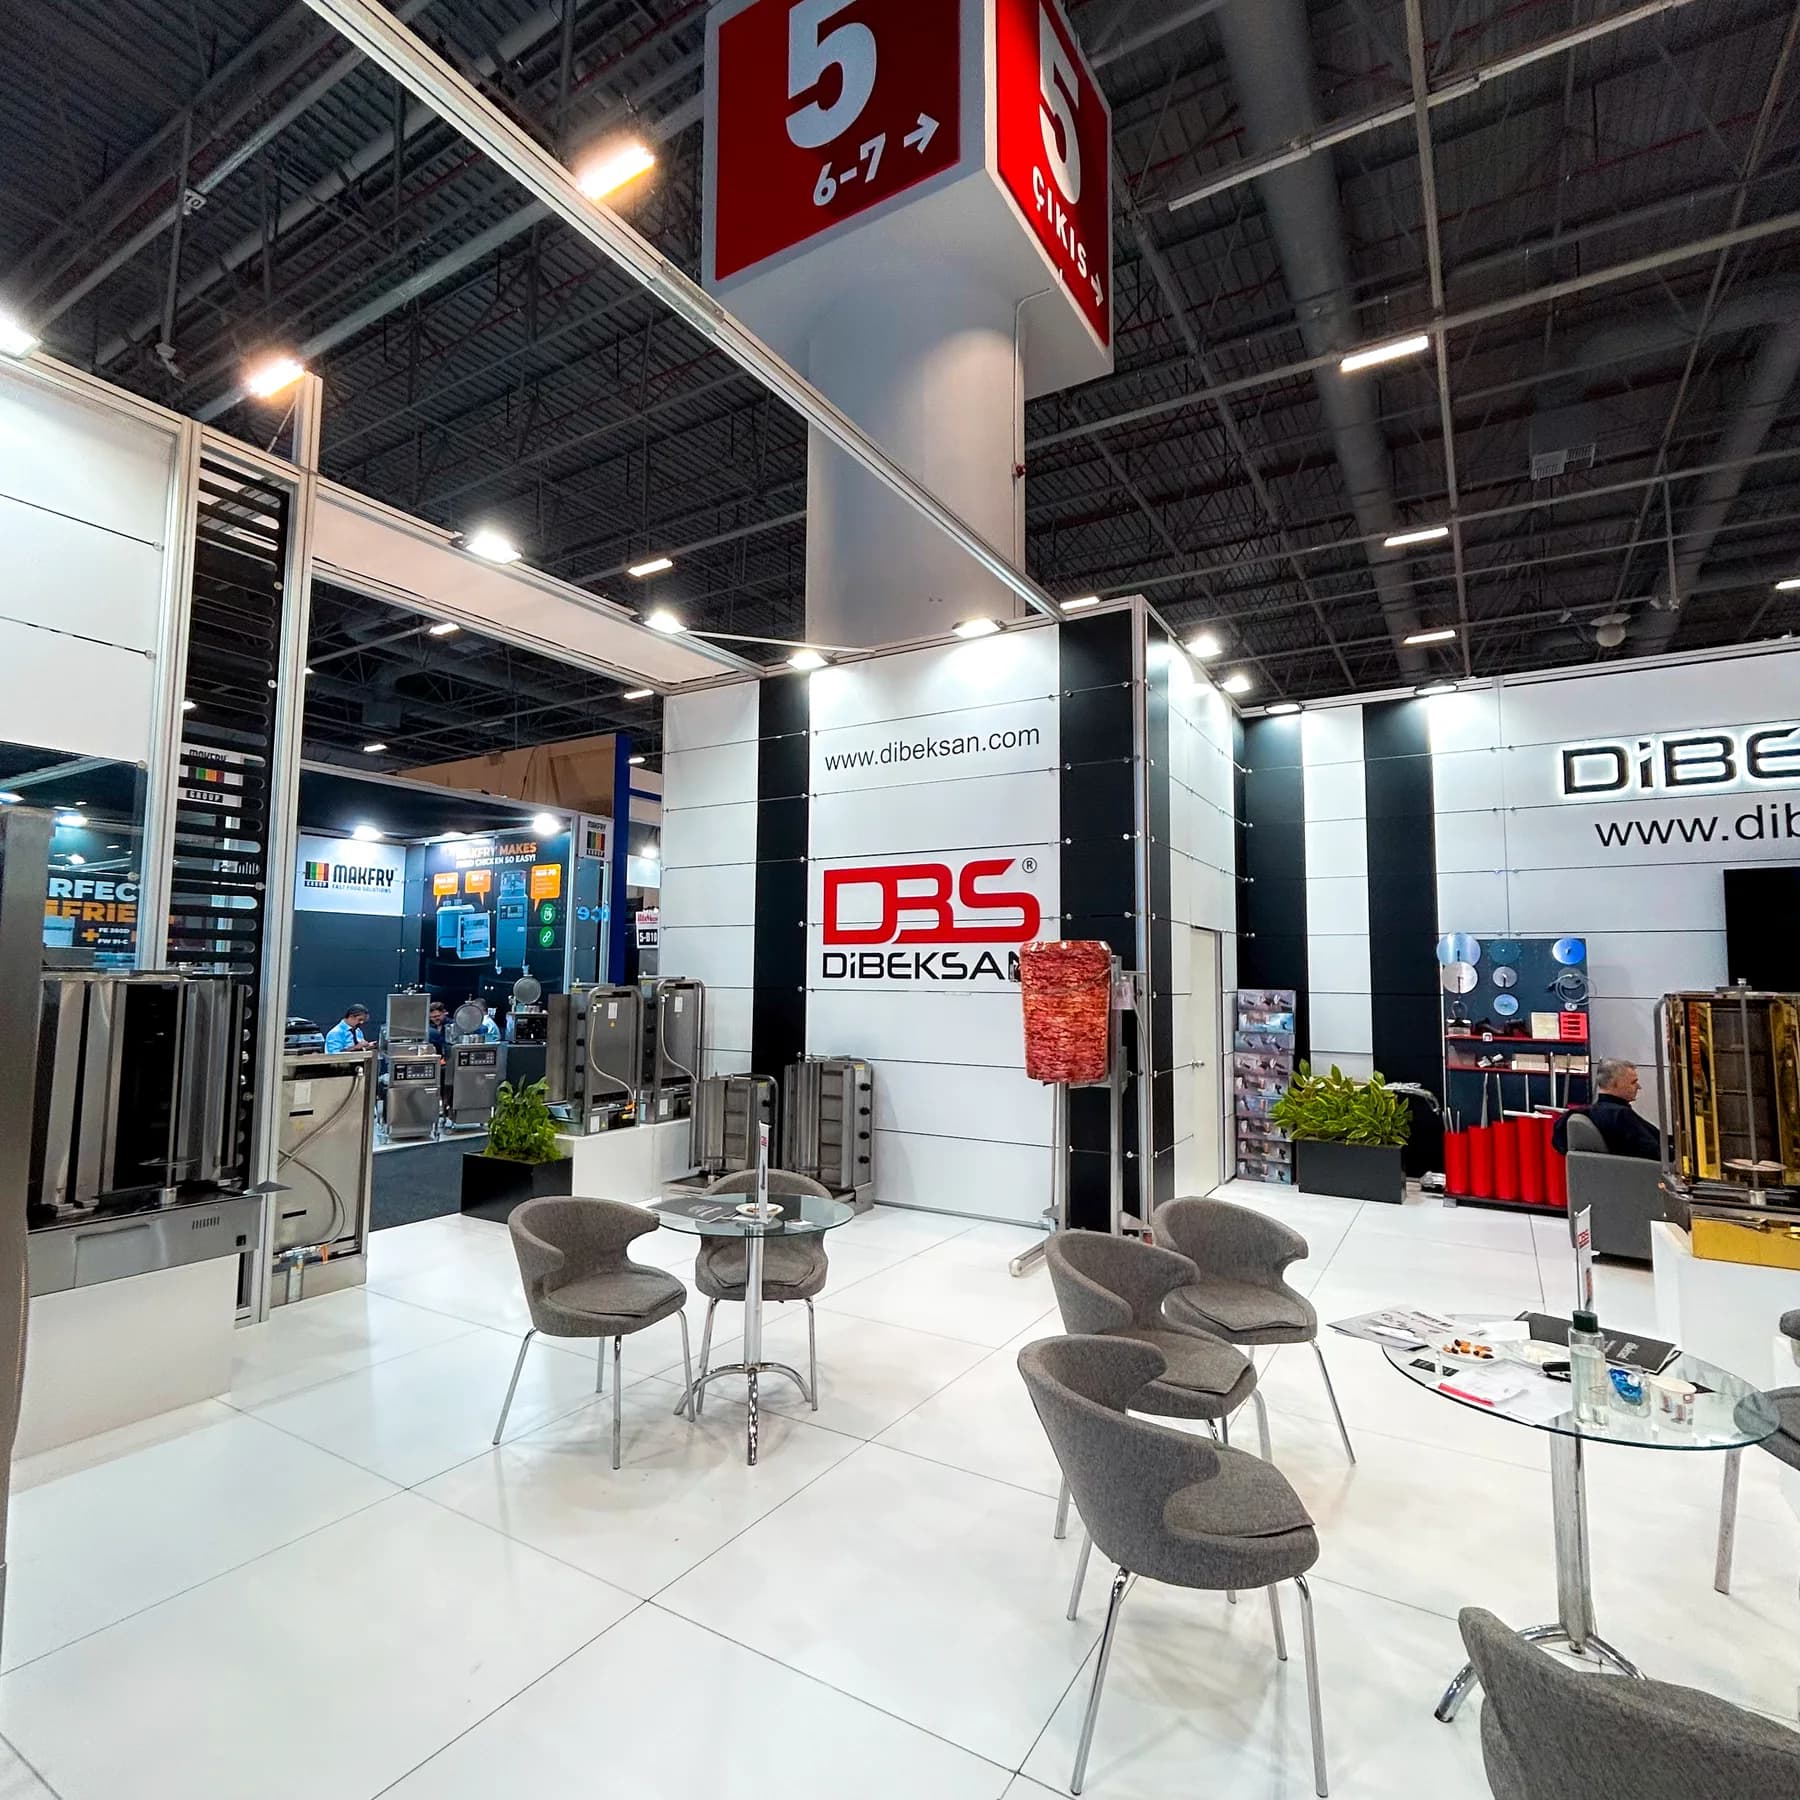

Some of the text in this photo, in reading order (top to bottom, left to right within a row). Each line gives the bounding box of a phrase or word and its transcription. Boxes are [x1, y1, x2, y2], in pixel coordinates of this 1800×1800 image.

[785, 0, 877, 149] 5
[1038, 0, 1081, 204] 5
[812, 132, 886, 206] 6-7
[824, 727, 1040, 771] www.dibeksan.com
[333, 864, 395, 887] MAKFRY
[500, 842, 537, 856] MAKES
[49, 877, 140, 902] RFEC
[823, 858, 1041, 945] DBS
